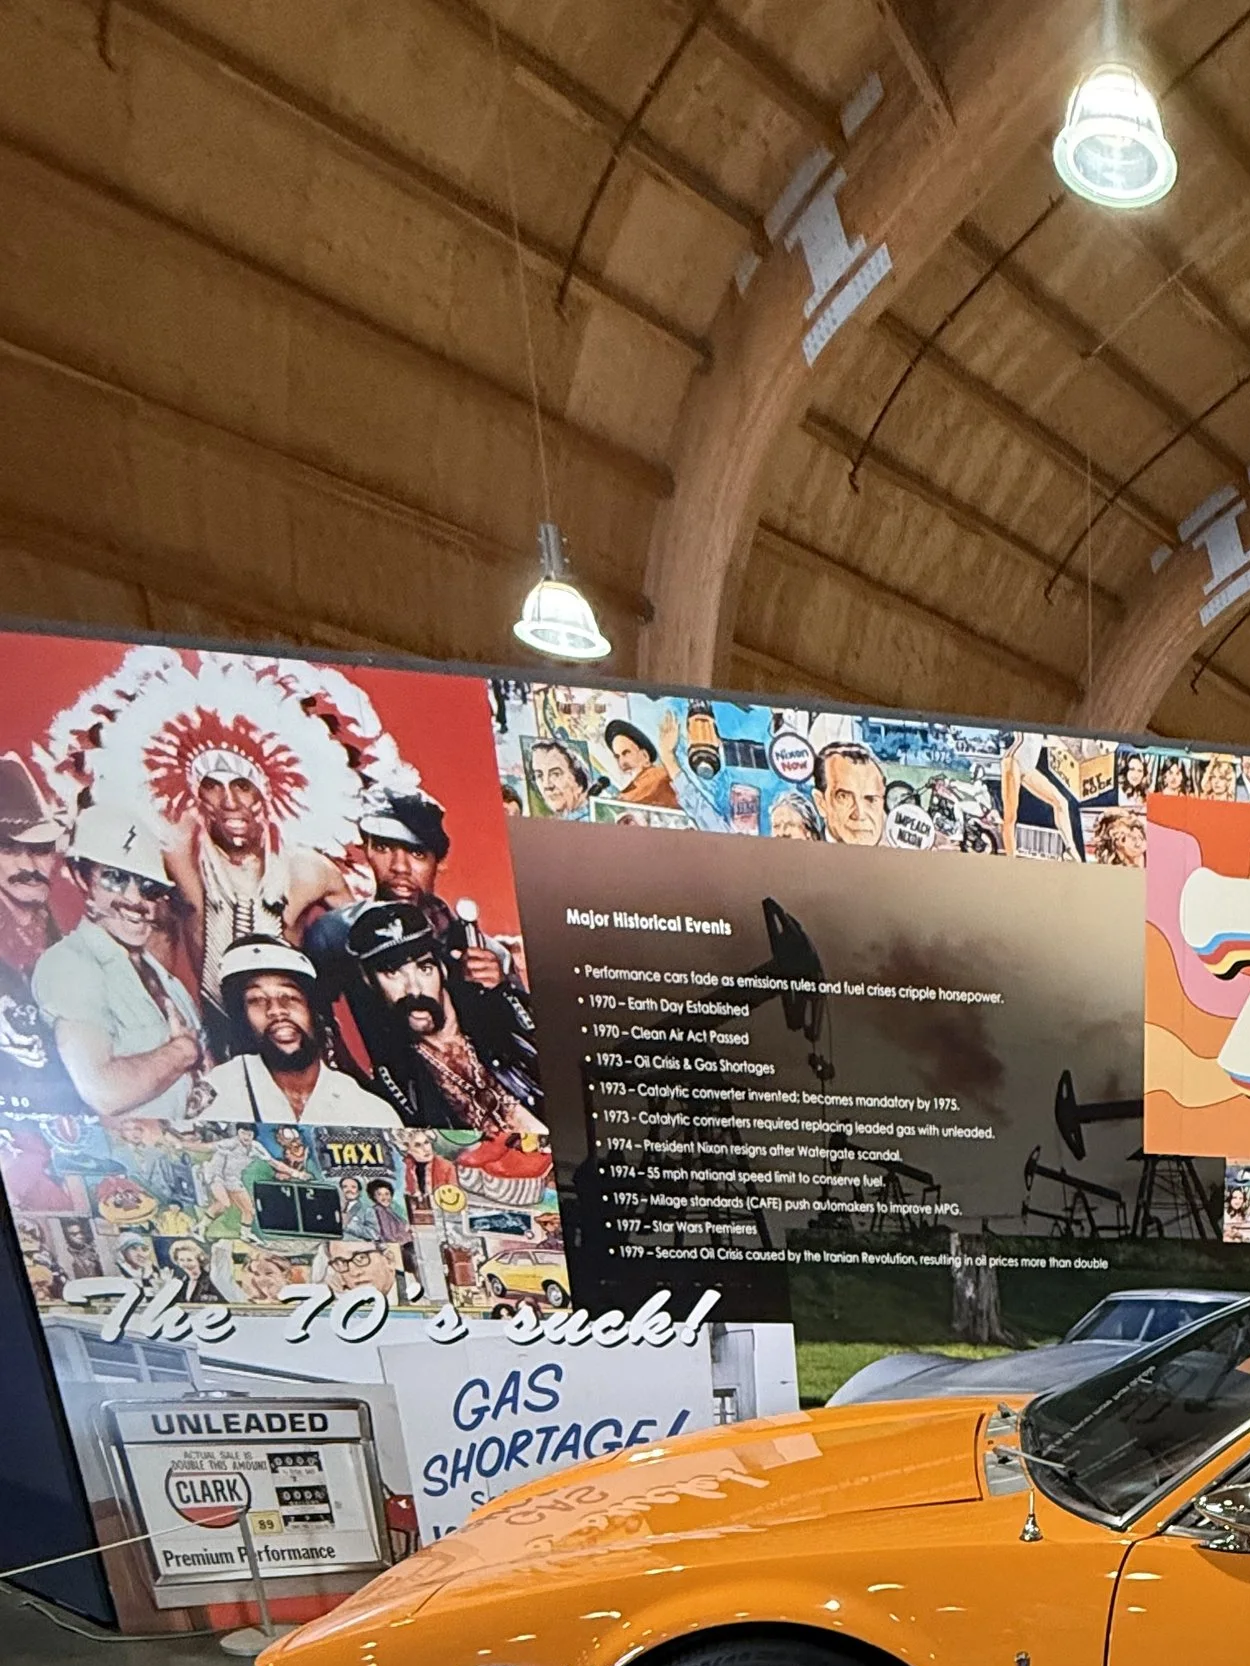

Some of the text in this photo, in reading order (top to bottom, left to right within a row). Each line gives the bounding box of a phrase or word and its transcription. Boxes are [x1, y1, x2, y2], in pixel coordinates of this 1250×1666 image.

[775, 748, 809, 761] Nixon
[781, 757, 808, 772] Now
[894, 811, 931, 837] IMPEACH
[566, 908, 732, 935] Major Historical Events
[584, 964, 661, 982] Performance
[662, 971, 689, 984] cars
[689, 971, 719, 986] fade
[720, 975, 735, 987] as
[735, 975, 789, 990] emissions
[789, 977, 816, 992] rules
[817, 981, 842, 994] and
[842, 981, 865, 995] fuel
[865, 983, 897, 998] crises
[897, 985, 937, 1001] cripple
[588, 994, 750, 1017] 1970 Earth Day Established
[592, 1023, 749, 1045] 1970 Clean Air Act Passed
[596, 1052, 775, 1076] 1973 Oil Crisis & Gas Shortages
[599, 1081, 627, 1095] 1973
[636, 1083, 689, 1100] Catalytic
[691, 1087, 746, 1101] converter
[801, 1090, 854, 1107] becomes
[854, 1095, 915, 1111] mandatory
[915, 1097, 931, 1112] by
[602, 1109, 630, 1123] 1973
[637, 1111, 691, 1128] Catalytic
[691, 1115, 751, 1128] converters
[752, 1118, 799, 1131] required
[800, 1119, 853, 1136] replacing
[854, 1121, 894, 1135] leaded
[895, 1125, 916, 1138] gas
[916, 1124, 939, 1136] with
[327, 1142, 385, 1166] TAXI
[606, 1137, 633, 1150] 1974
[642, 1138, 695, 1153] President
[696, 1141, 729, 1154] Nixon
[729, 1143, 767, 1158] resigns
[768, 1144, 795, 1157] after
[796, 1145, 855, 1162] Watergate
[609, 1164, 636, 1178] 1974
[646, 1166, 660, 1179] 55
[661, 1167, 689, 1182] mph
[689, 1168, 736, 1182] national
[737, 1171, 773, 1184] speed
[773, 1171, 796, 1183] limit
[797, 1172, 810, 1184] to
[811, 1174, 861, 1187] conserve
[612, 1192, 639, 1205] 1975
[649, 1193, 688, 1209] Milage
[689, 1194, 744, 1208] standards
[745, 1196, 782, 1211] (CAFE)
[784, 1198, 810, 1211] push
[811, 1198, 875, 1213] automakers
[875, 1201, 888, 1213] to
[888, 1200, 932, 1217] improve
[619, 1245, 645, 1258] 1979
[654, 1246, 698, 1259] Second
[698, 1247, 715, 1260] Oil
[716, 1248, 744, 1260] Crisis
[744, 1249, 786, 1261] caused
[786, 1249, 802, 1263] by
[802, 1250, 821, 1262] the
[822, 1250, 860, 1263] Iranian
[918, 1254, 962, 1271] resulting
[963, 1254, 973, 1266] in
[974, 1254, 987, 1266] oil
[988, 1255, 1019, 1268] prices
[1020, 1258, 1046, 1268] more
[1048, 1256, 1072, 1268] than
[1072, 1257, 1108, 1269] double
[62, 1276, 236, 1344] The
[504, 1289, 721, 1348] suck!
[452, 1363, 564, 1432] GAS
[151, 1412, 329, 1435] UNLEADED
[171, 1461, 204, 1471] DOUBLE
[209, 1460, 228, 1471] THIS
[232, 1460, 268, 1471] AMOUNT
[183, 1451, 216, 1460] ACTUAL
[220, 1450, 241, 1460] SALE
[175, 1478, 244, 1505] CLARK
[258, 1519, 274, 1530] 89
[162, 1544, 336, 1568] Premium Prformance
